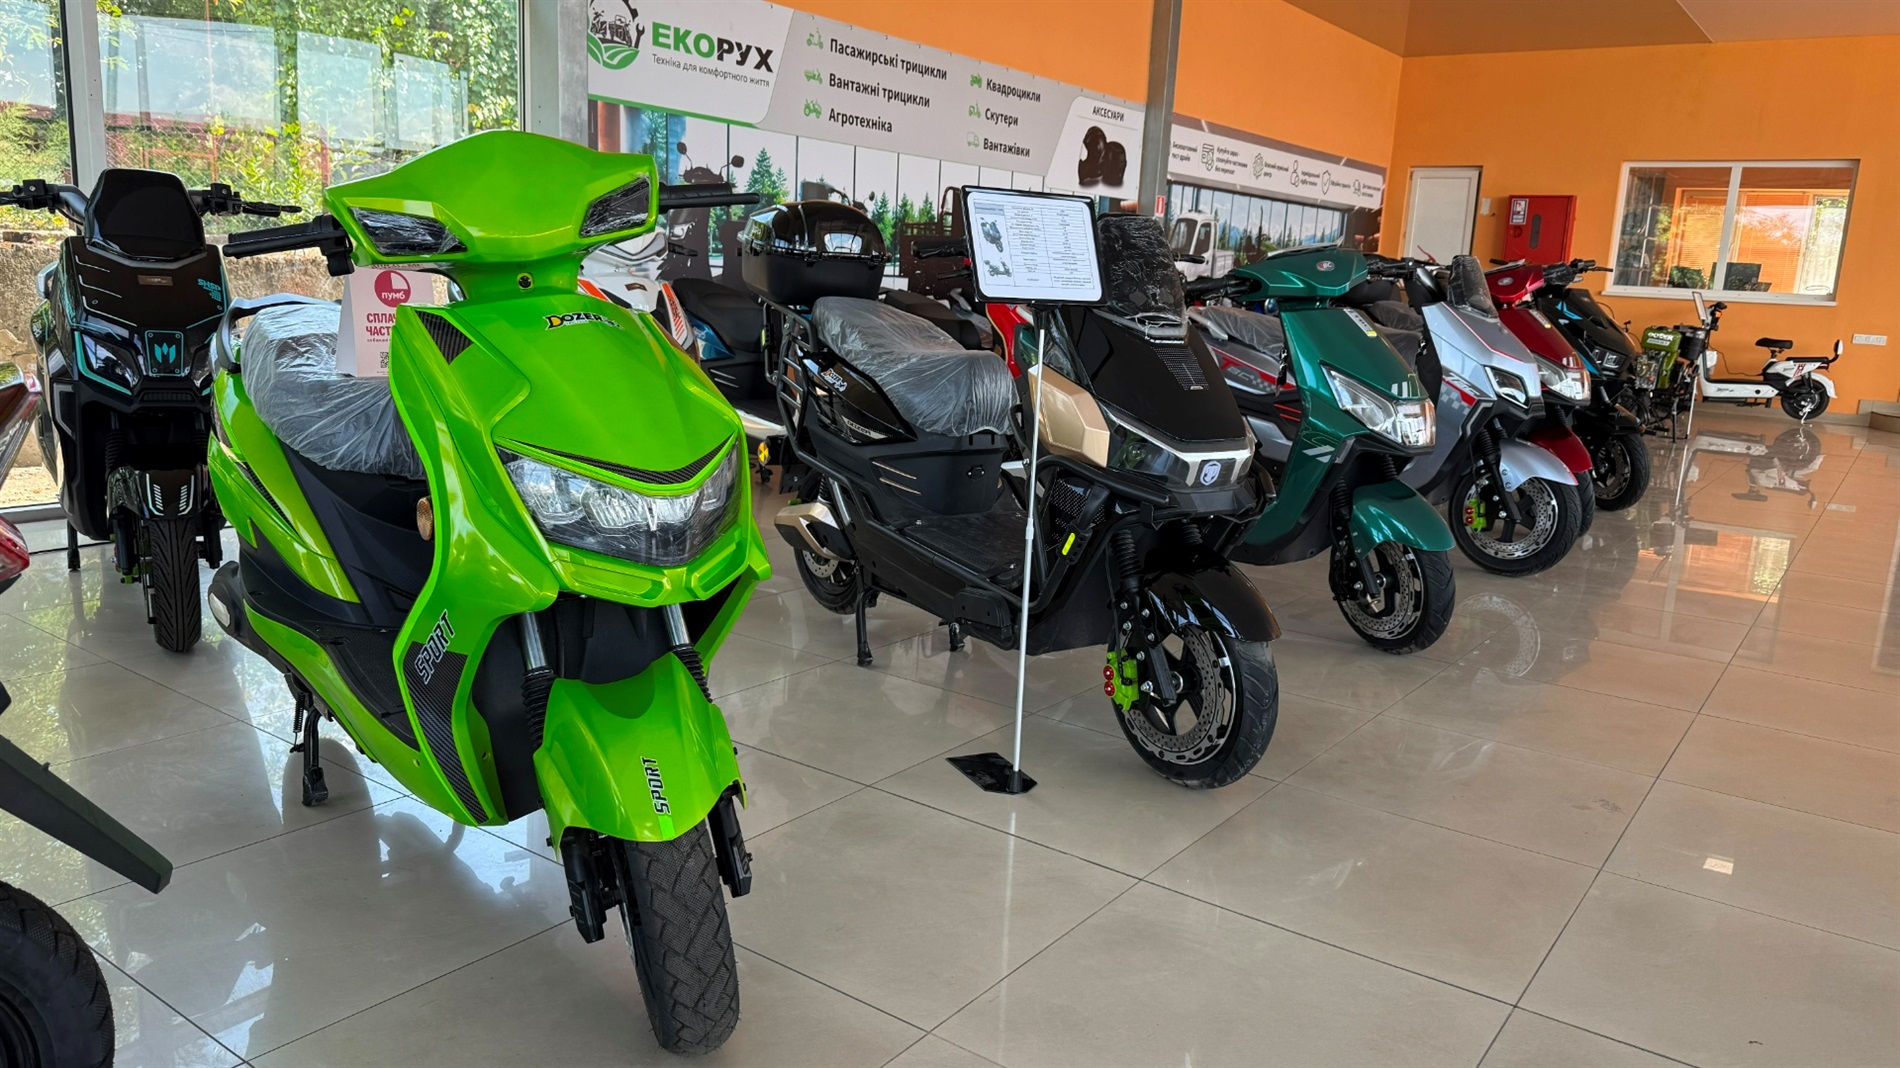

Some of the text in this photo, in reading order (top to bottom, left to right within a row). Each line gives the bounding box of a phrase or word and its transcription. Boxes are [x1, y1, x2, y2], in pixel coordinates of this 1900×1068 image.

[652, 21, 774, 73] ЕКОРУХ
[830, 38, 947, 80] Пасажирські трицикли
[652, 54, 770, 88] Техніка для комфортного життя
[829, 73, 930, 108] Вантажні трицикли
[986, 78, 1041, 102] Квадроцикли
[828, 108, 893, 133] Агротехніка
[984, 108, 1019, 127] Скутери
[1092, 106, 1125, 122] АКСЕСУАРИ
[983, 138, 1030, 158] Вантажівки
[382, 291, 406, 301] пумб
[543, 312, 603, 330] DOZER
[414, 608, 456, 685] SPORT
[640, 756, 672, 815] SPORT
